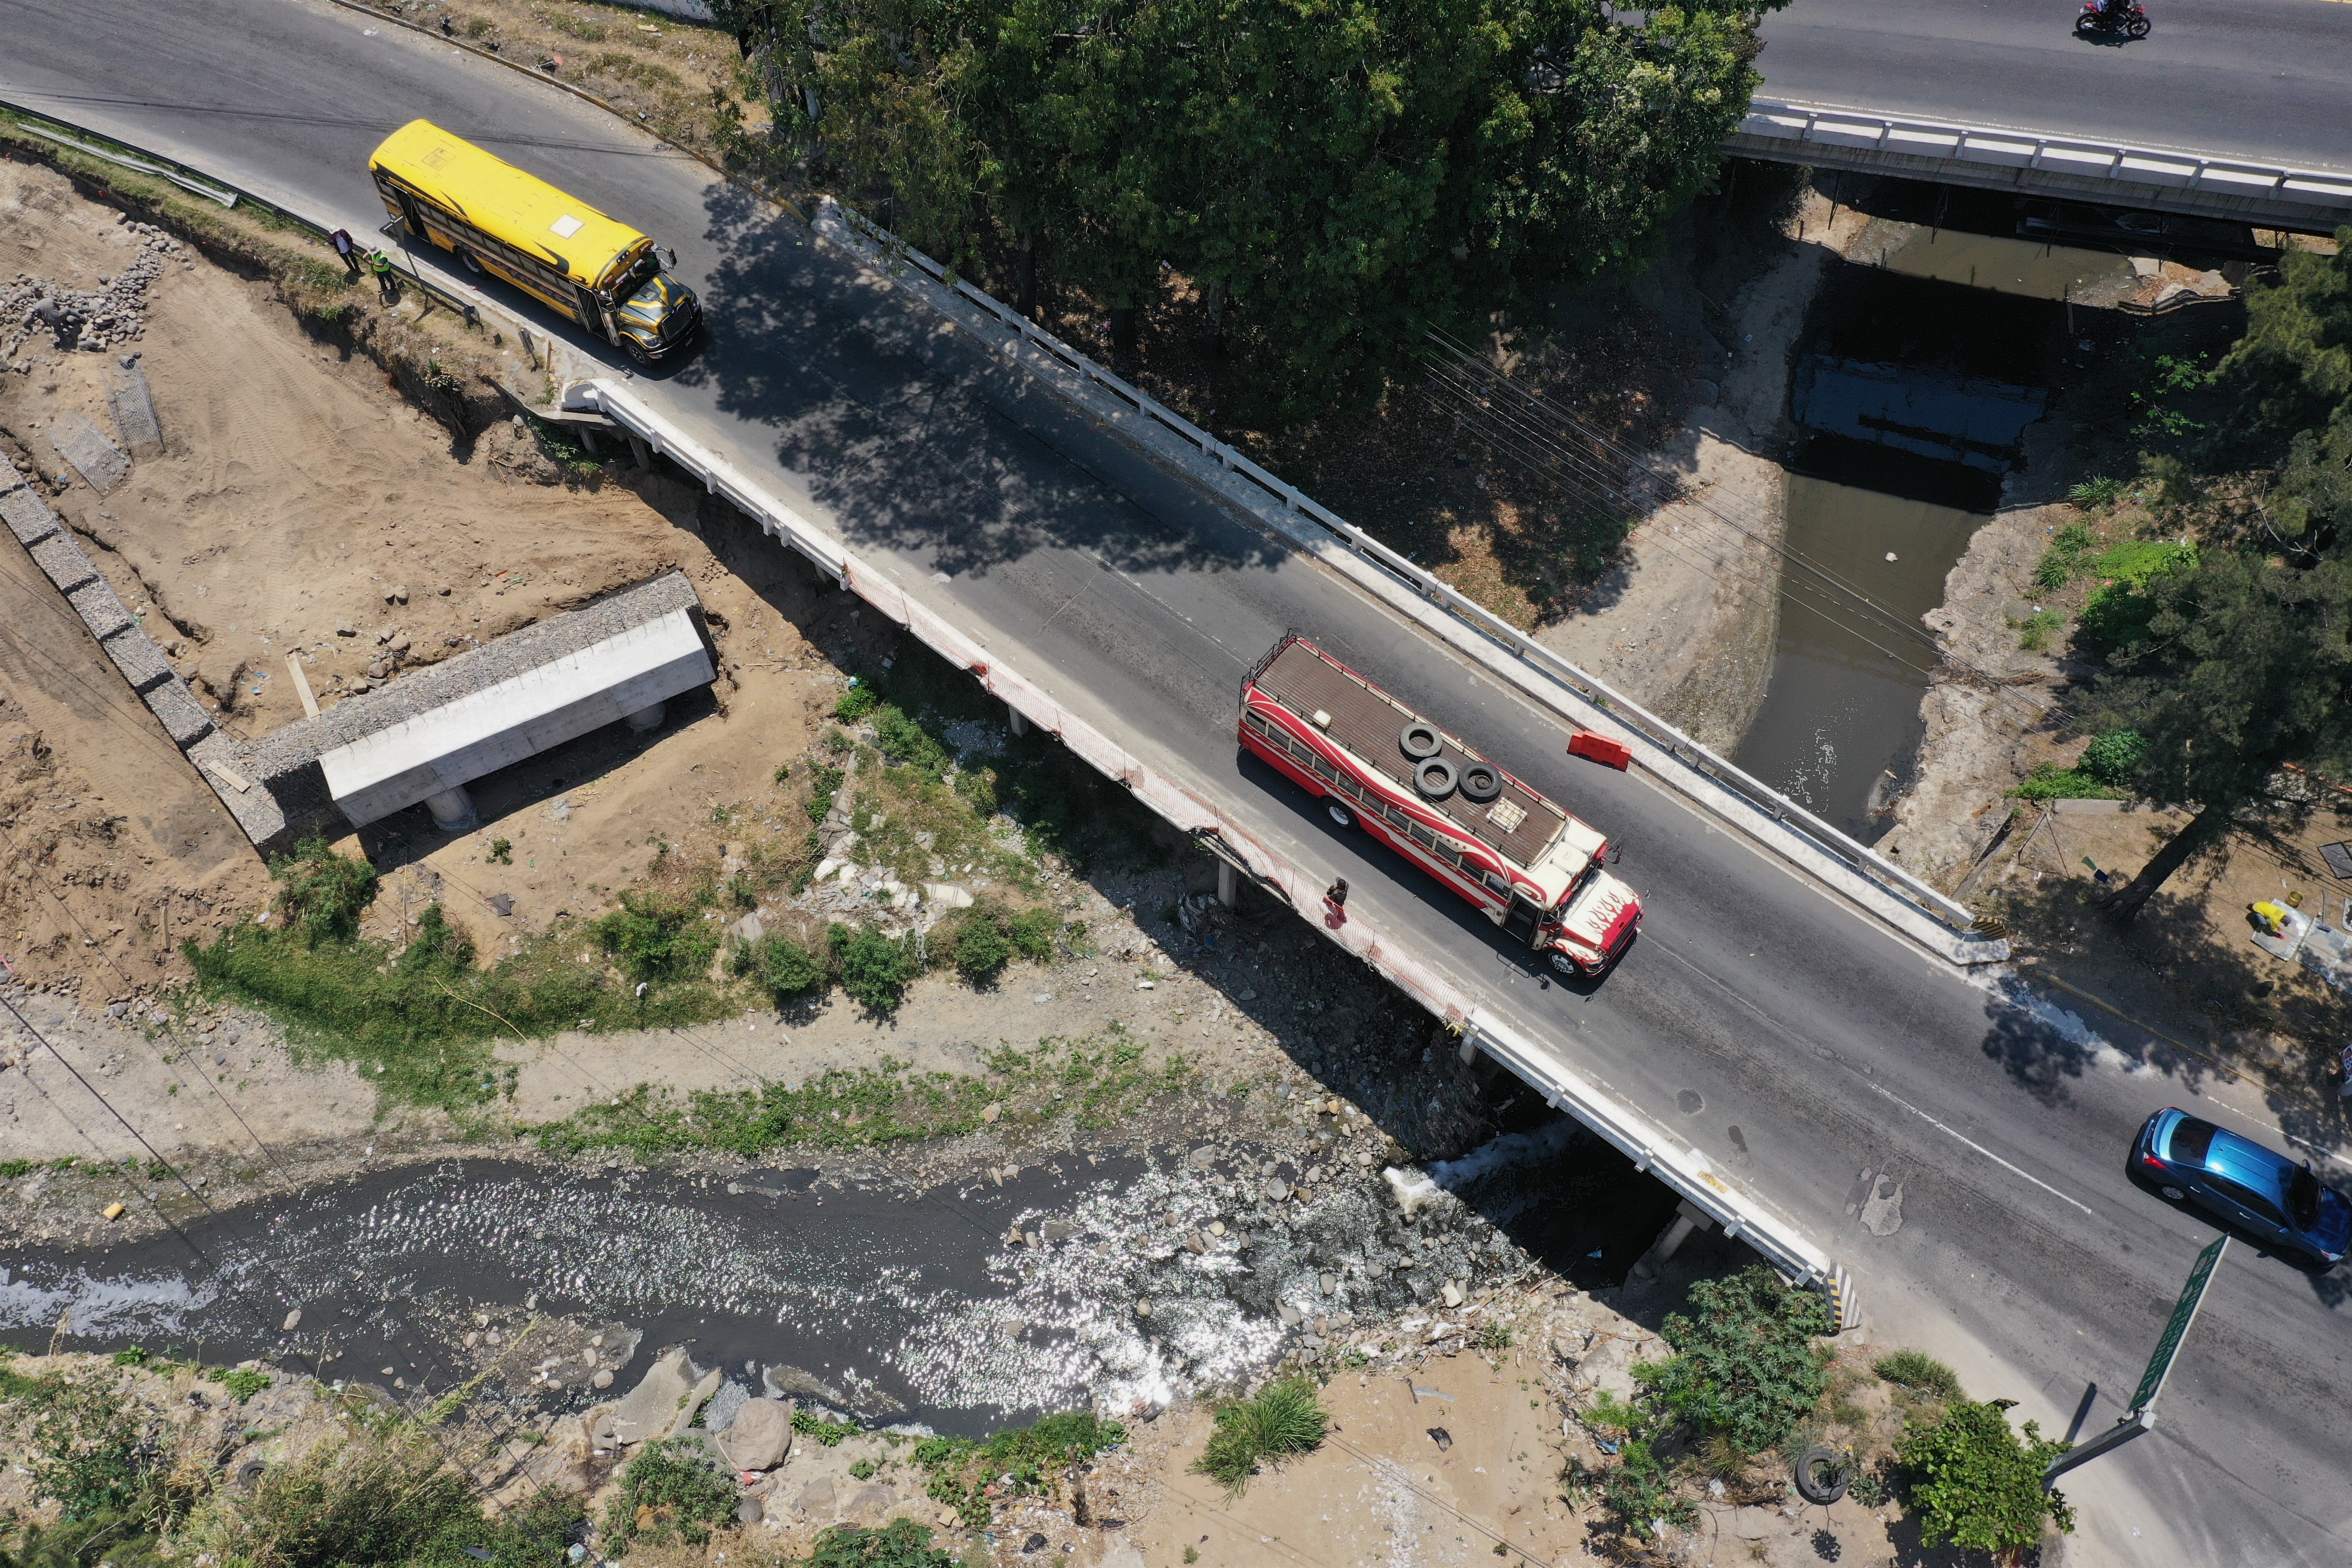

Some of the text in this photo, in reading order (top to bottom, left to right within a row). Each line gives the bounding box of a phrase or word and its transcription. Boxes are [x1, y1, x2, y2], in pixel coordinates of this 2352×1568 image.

[2135, 1311, 2182, 1400] ESCUINTLA
[2158, 1241, 2222, 1369] SAN CRISTOBAL
